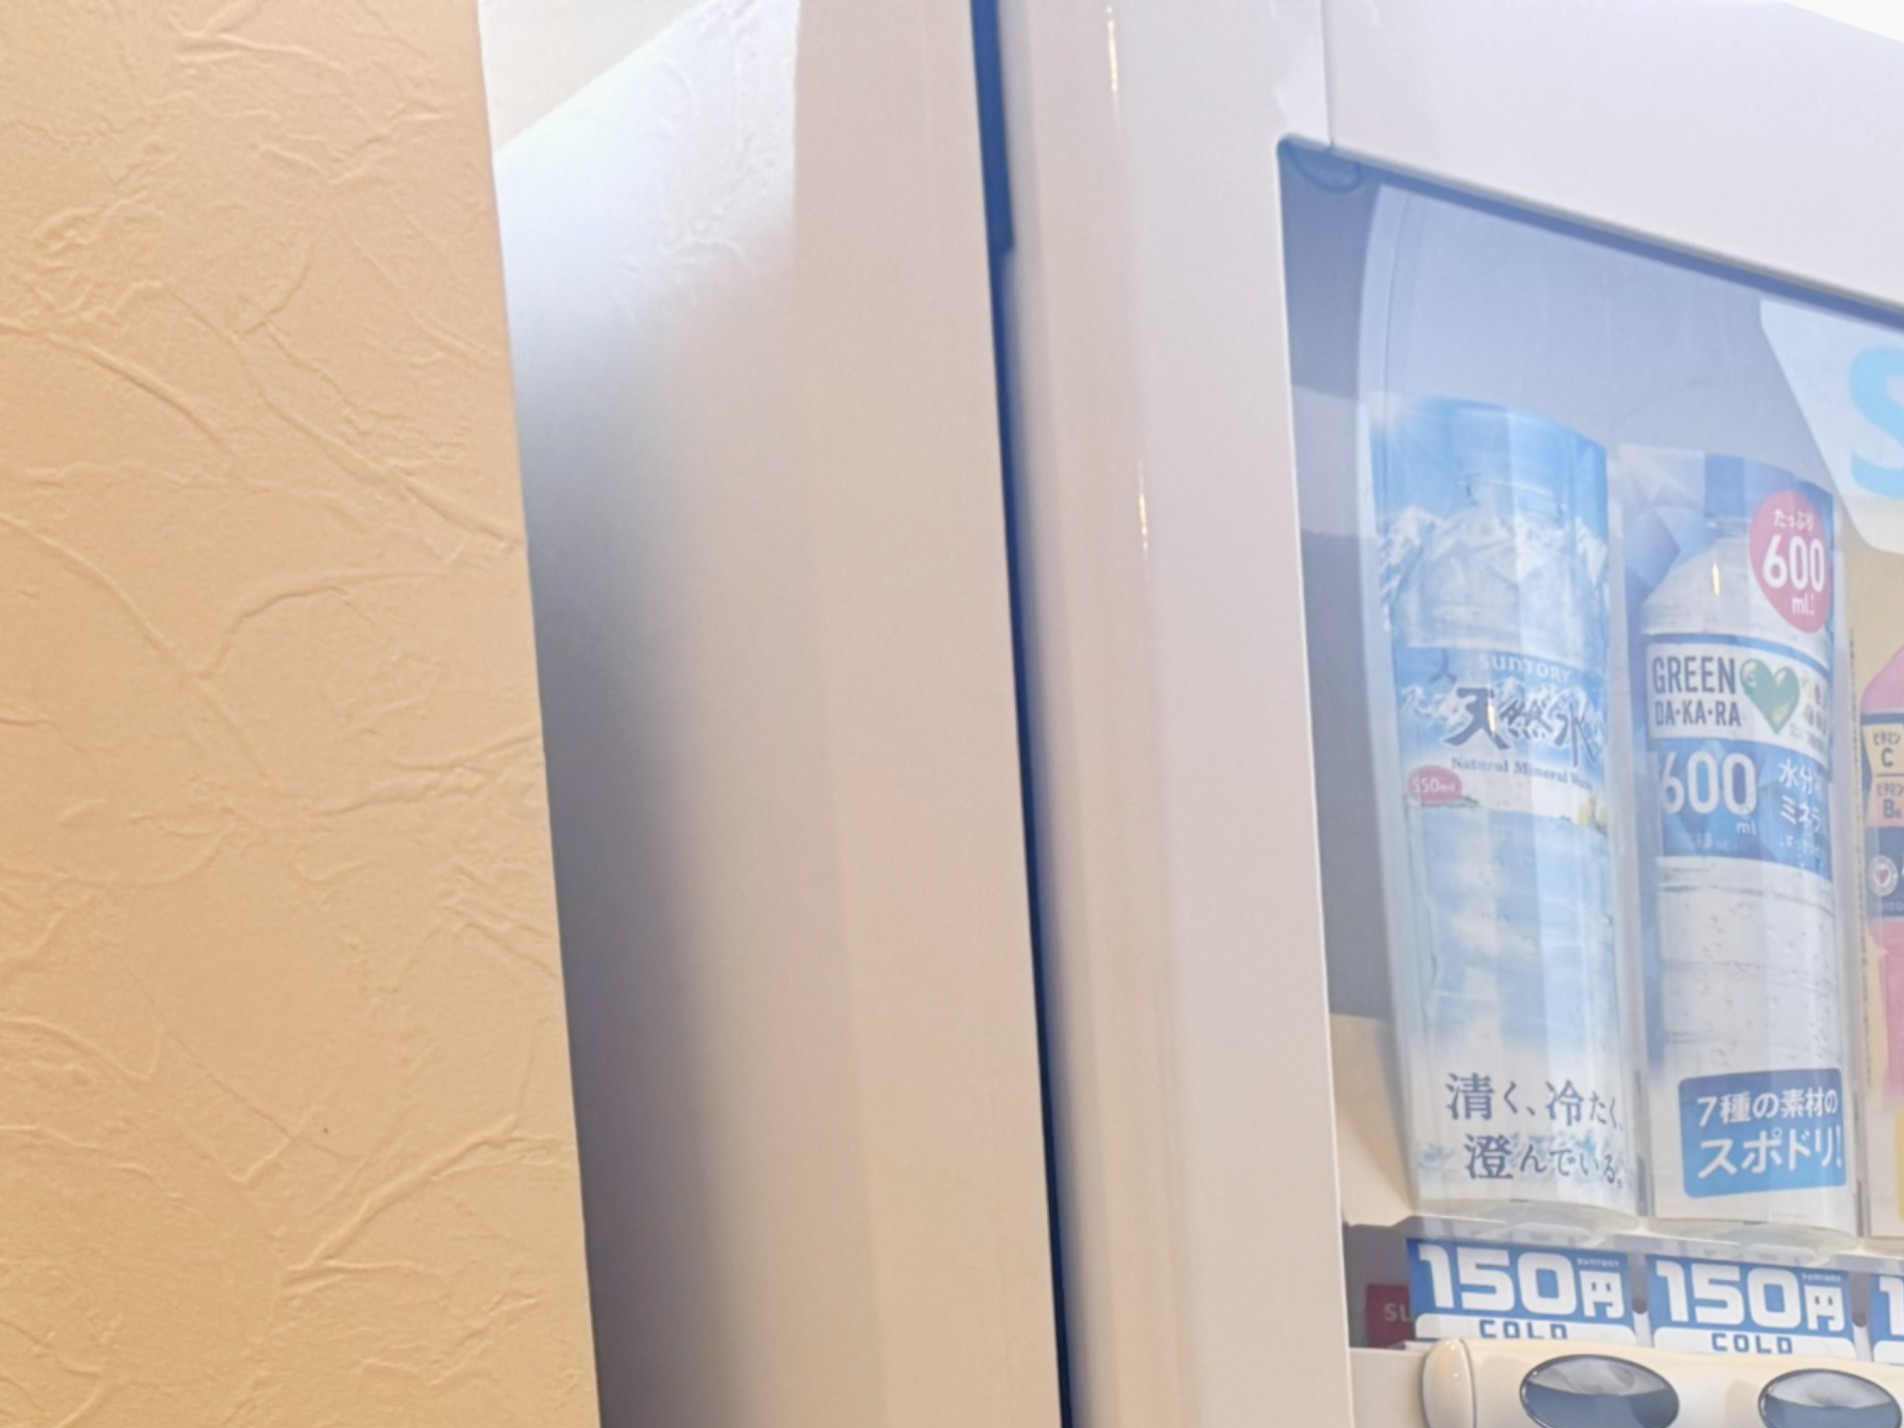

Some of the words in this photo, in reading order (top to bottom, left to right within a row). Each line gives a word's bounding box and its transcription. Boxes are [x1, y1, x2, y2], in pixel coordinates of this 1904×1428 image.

[1762, 538, 1826, 592] 600
[1652, 654, 1737, 696] GREEN
[1881, 747, 1894, 768] C
[1662, 750, 1758, 818] 600
[1696, 1084, 1839, 1128] 7種の素材の
[1419, 1246, 1626, 1320] 150円
[1655, 1261, 1846, 1332] 150円
[1479, 1318, 1569, 1341] COLD
[1710, 1331, 1795, 1356] COLD
